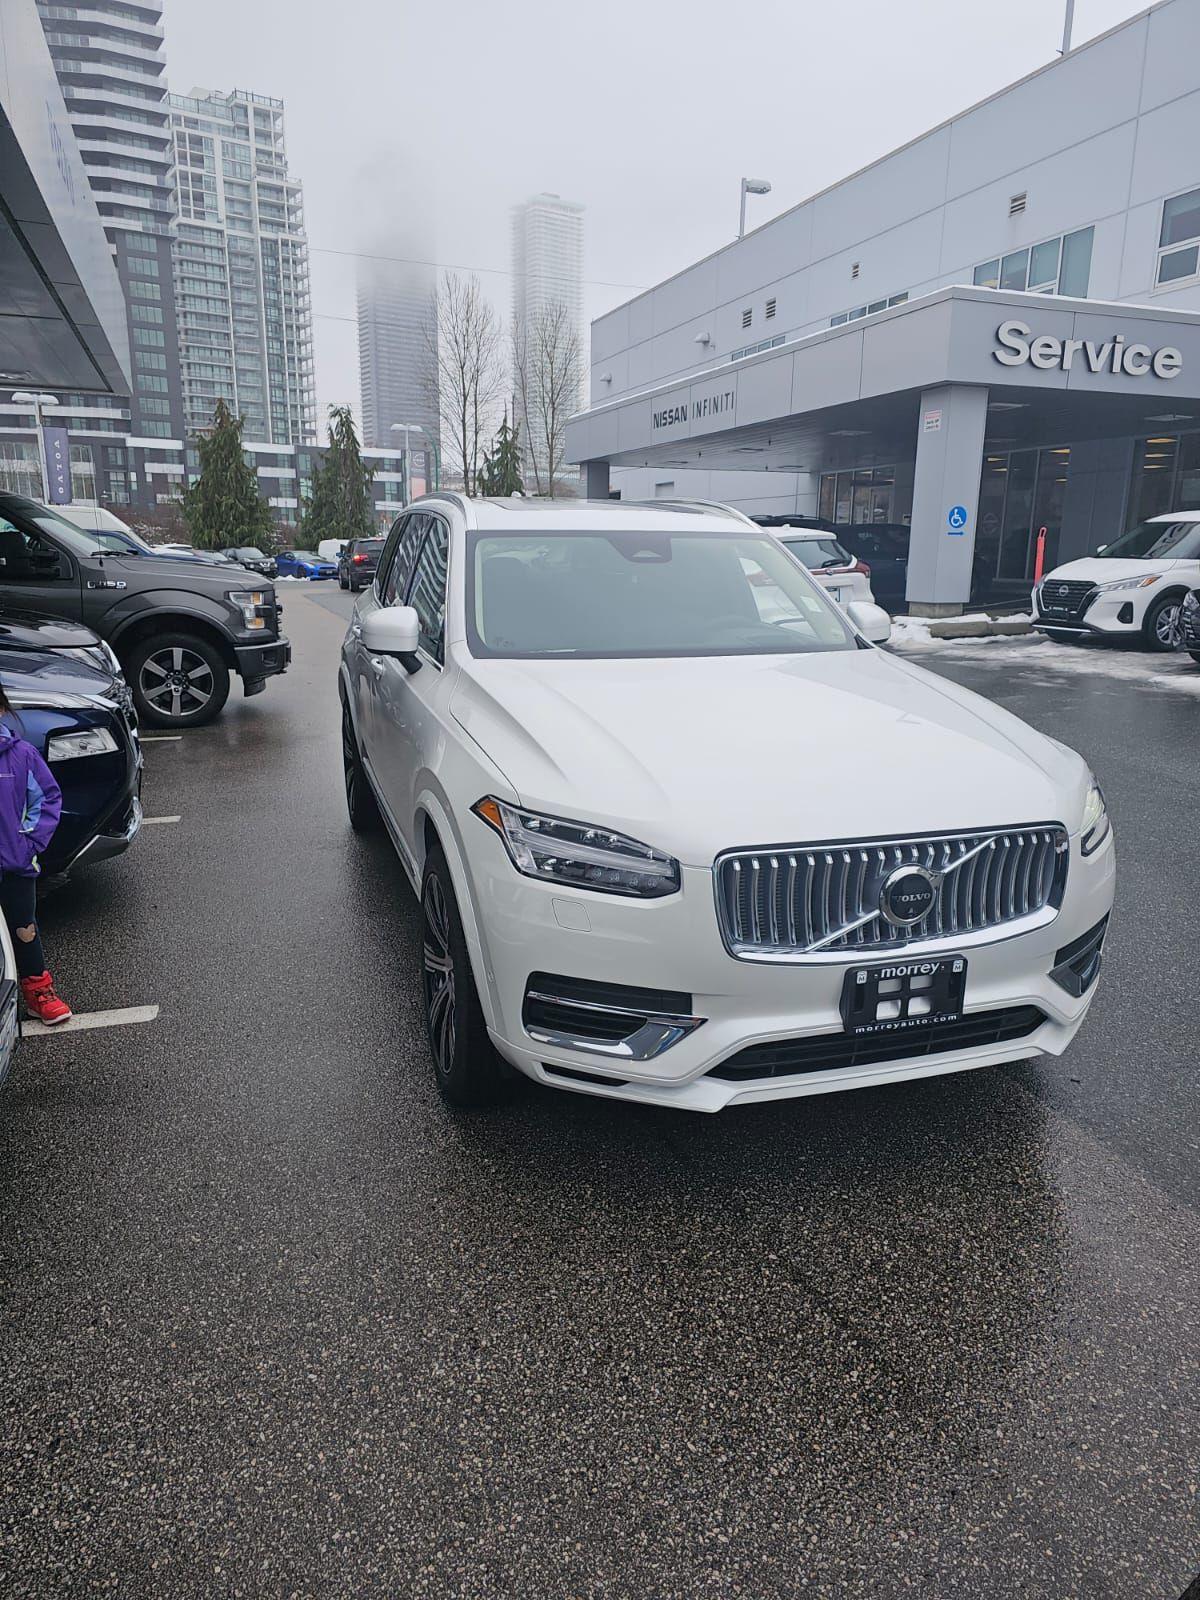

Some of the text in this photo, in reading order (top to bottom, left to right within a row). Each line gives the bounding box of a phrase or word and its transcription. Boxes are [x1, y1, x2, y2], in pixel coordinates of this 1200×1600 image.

[993, 320, 1182, 379] Service
[653, 404, 688, 429] NISSAN
[692, 391, 734, 419] INFINITI
[54, 440, 64, 494] VOLVO
[893, 892, 931, 903] VOLVO
[881, 962, 940, 978] morrey
[855, 1014, 957, 1034] morreyauto.com
